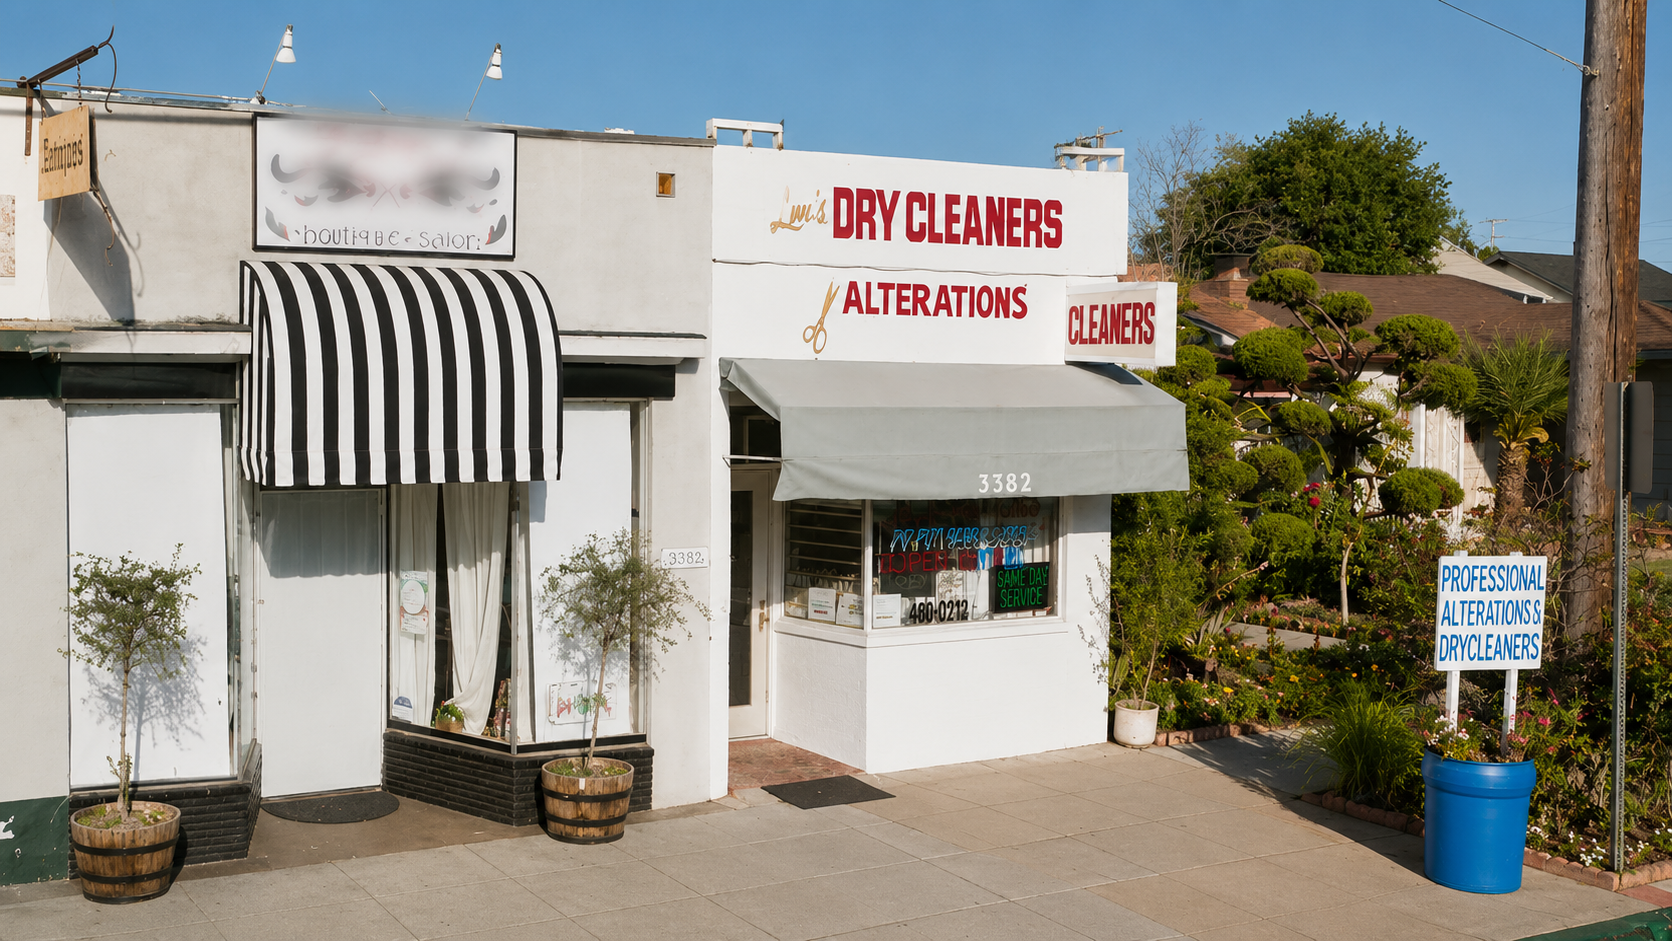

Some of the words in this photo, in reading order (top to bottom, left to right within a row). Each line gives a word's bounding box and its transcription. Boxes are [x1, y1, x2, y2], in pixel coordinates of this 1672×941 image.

[833, 186, 901, 240] DRY
[905, 191, 1063, 249] CLEANERS
[842, 280, 1028, 320] ALTERATIONS
[1068, 301, 1156, 345] CLEANERS
[978, 472, 1032, 493] 3382
[668, 551, 704, 565] 3382
[997, 569, 1026, 588] SAME
[1029, 565, 1049, 586] DAY
[1441, 564, 1545, 592] PROFESSIONAL
[1000, 586, 1043, 608] SERVICE
[1440, 599, 1531, 626] ALTERATIONS
[1532, 599, 1542, 625] &
[1439, 632, 1540, 662] DRYCLEANERS
